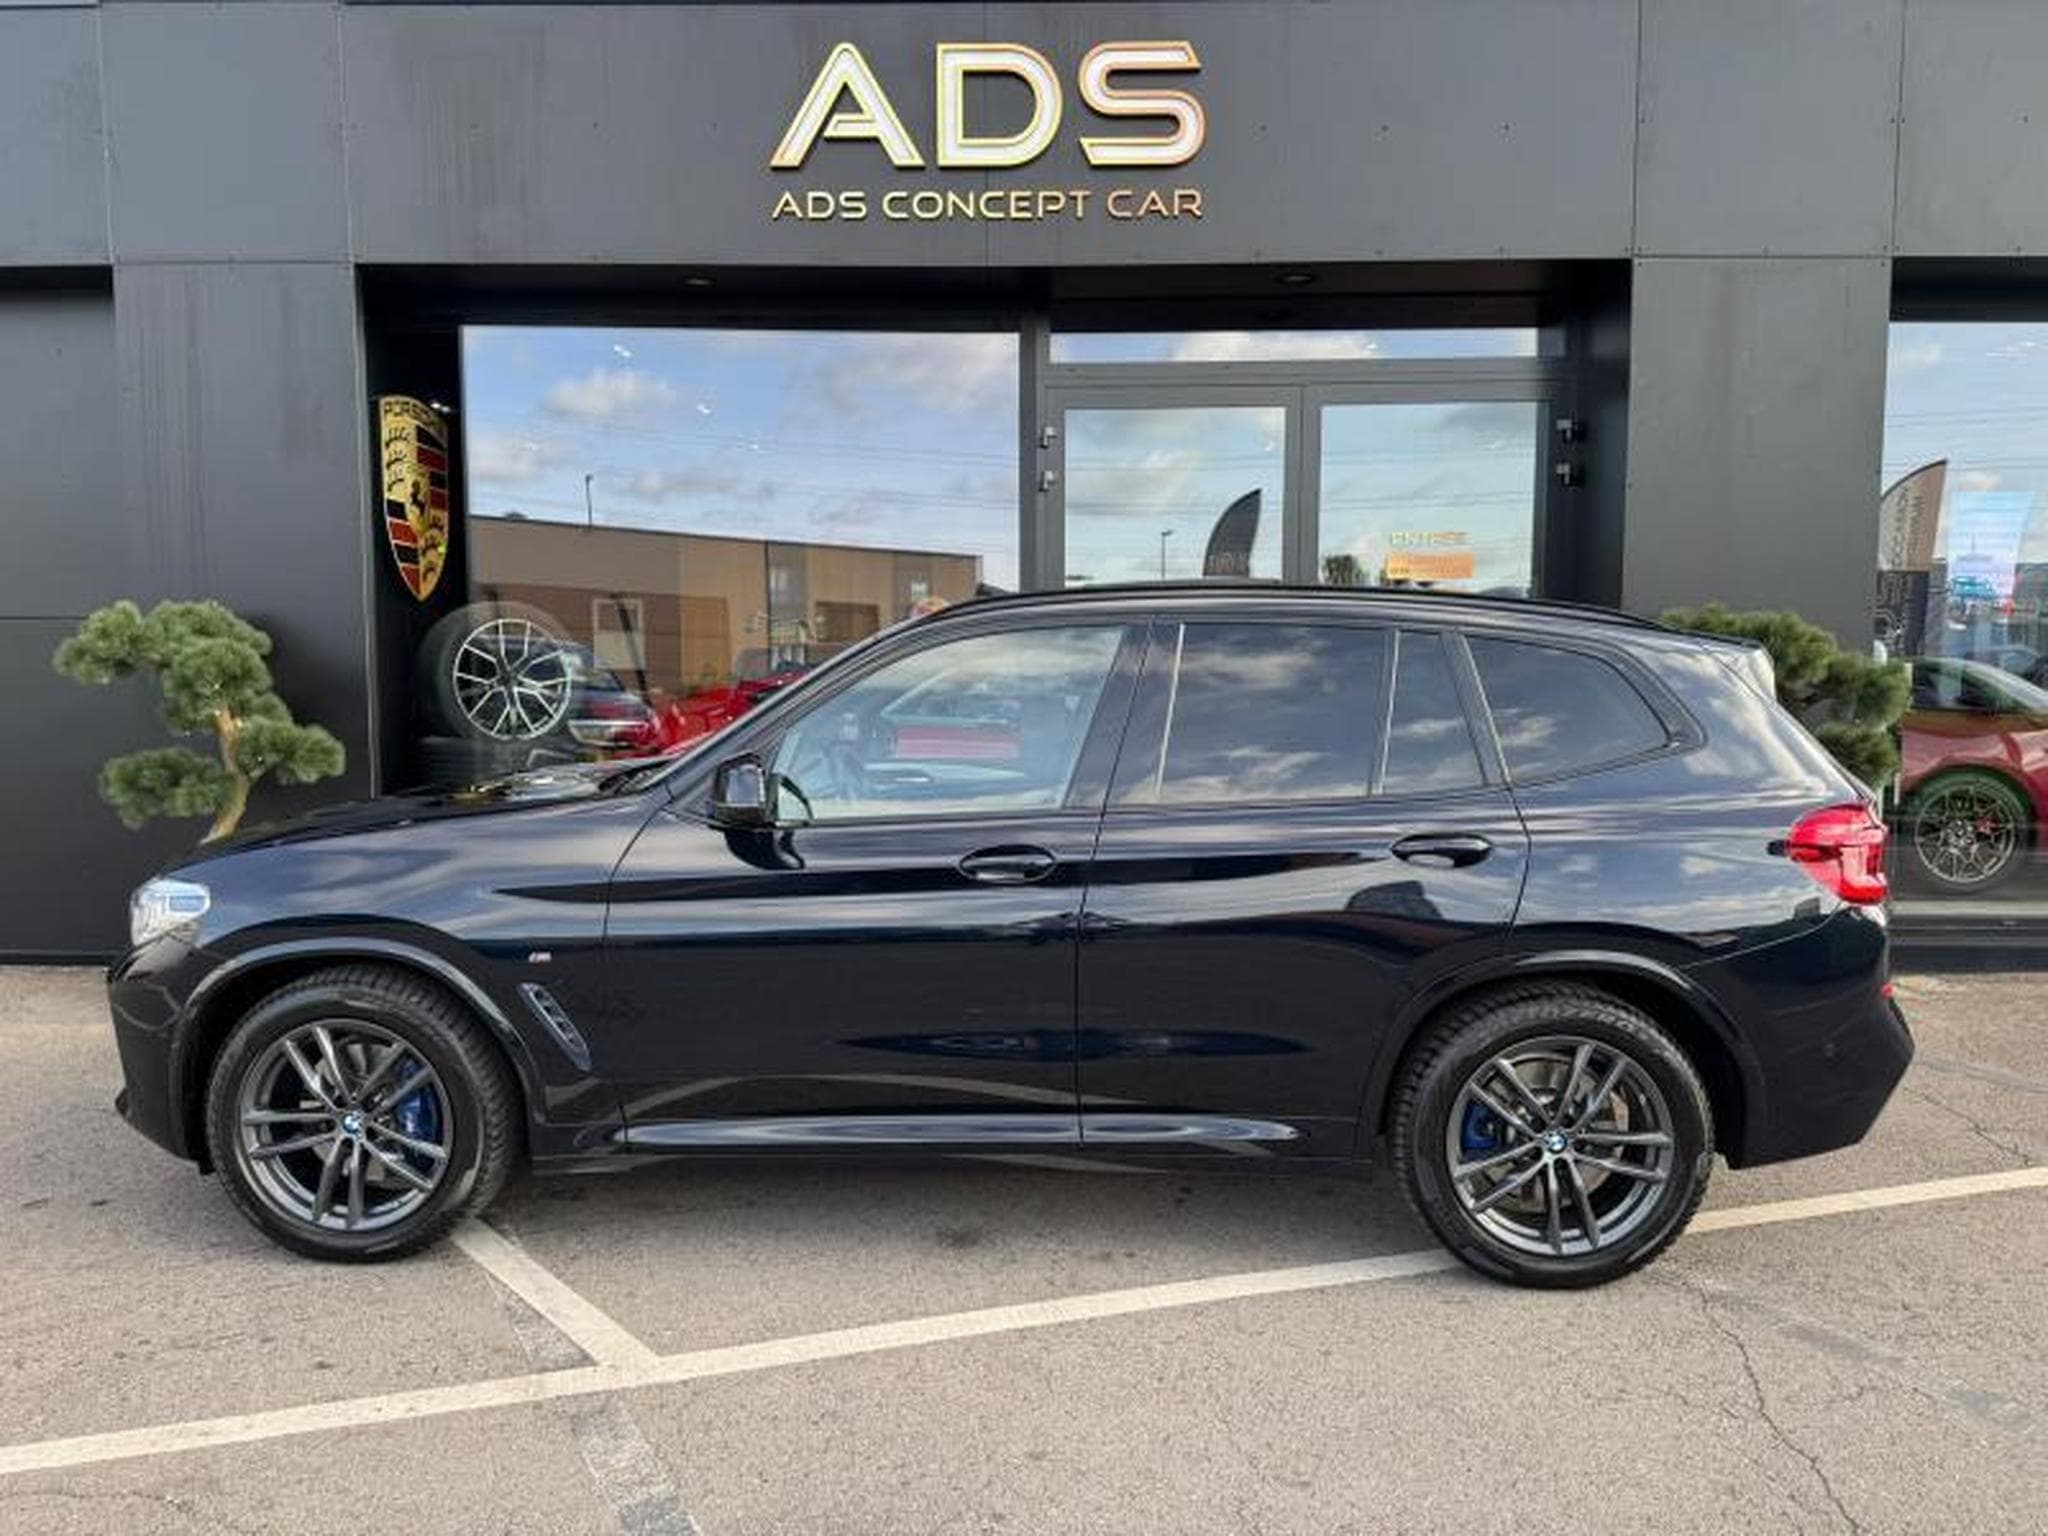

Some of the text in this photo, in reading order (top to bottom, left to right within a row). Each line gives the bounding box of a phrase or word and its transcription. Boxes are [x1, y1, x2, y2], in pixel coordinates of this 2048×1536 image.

[770, 41, 1206, 167] ADS
[772, 188, 1202, 219] ADS CONCEPT CAR
